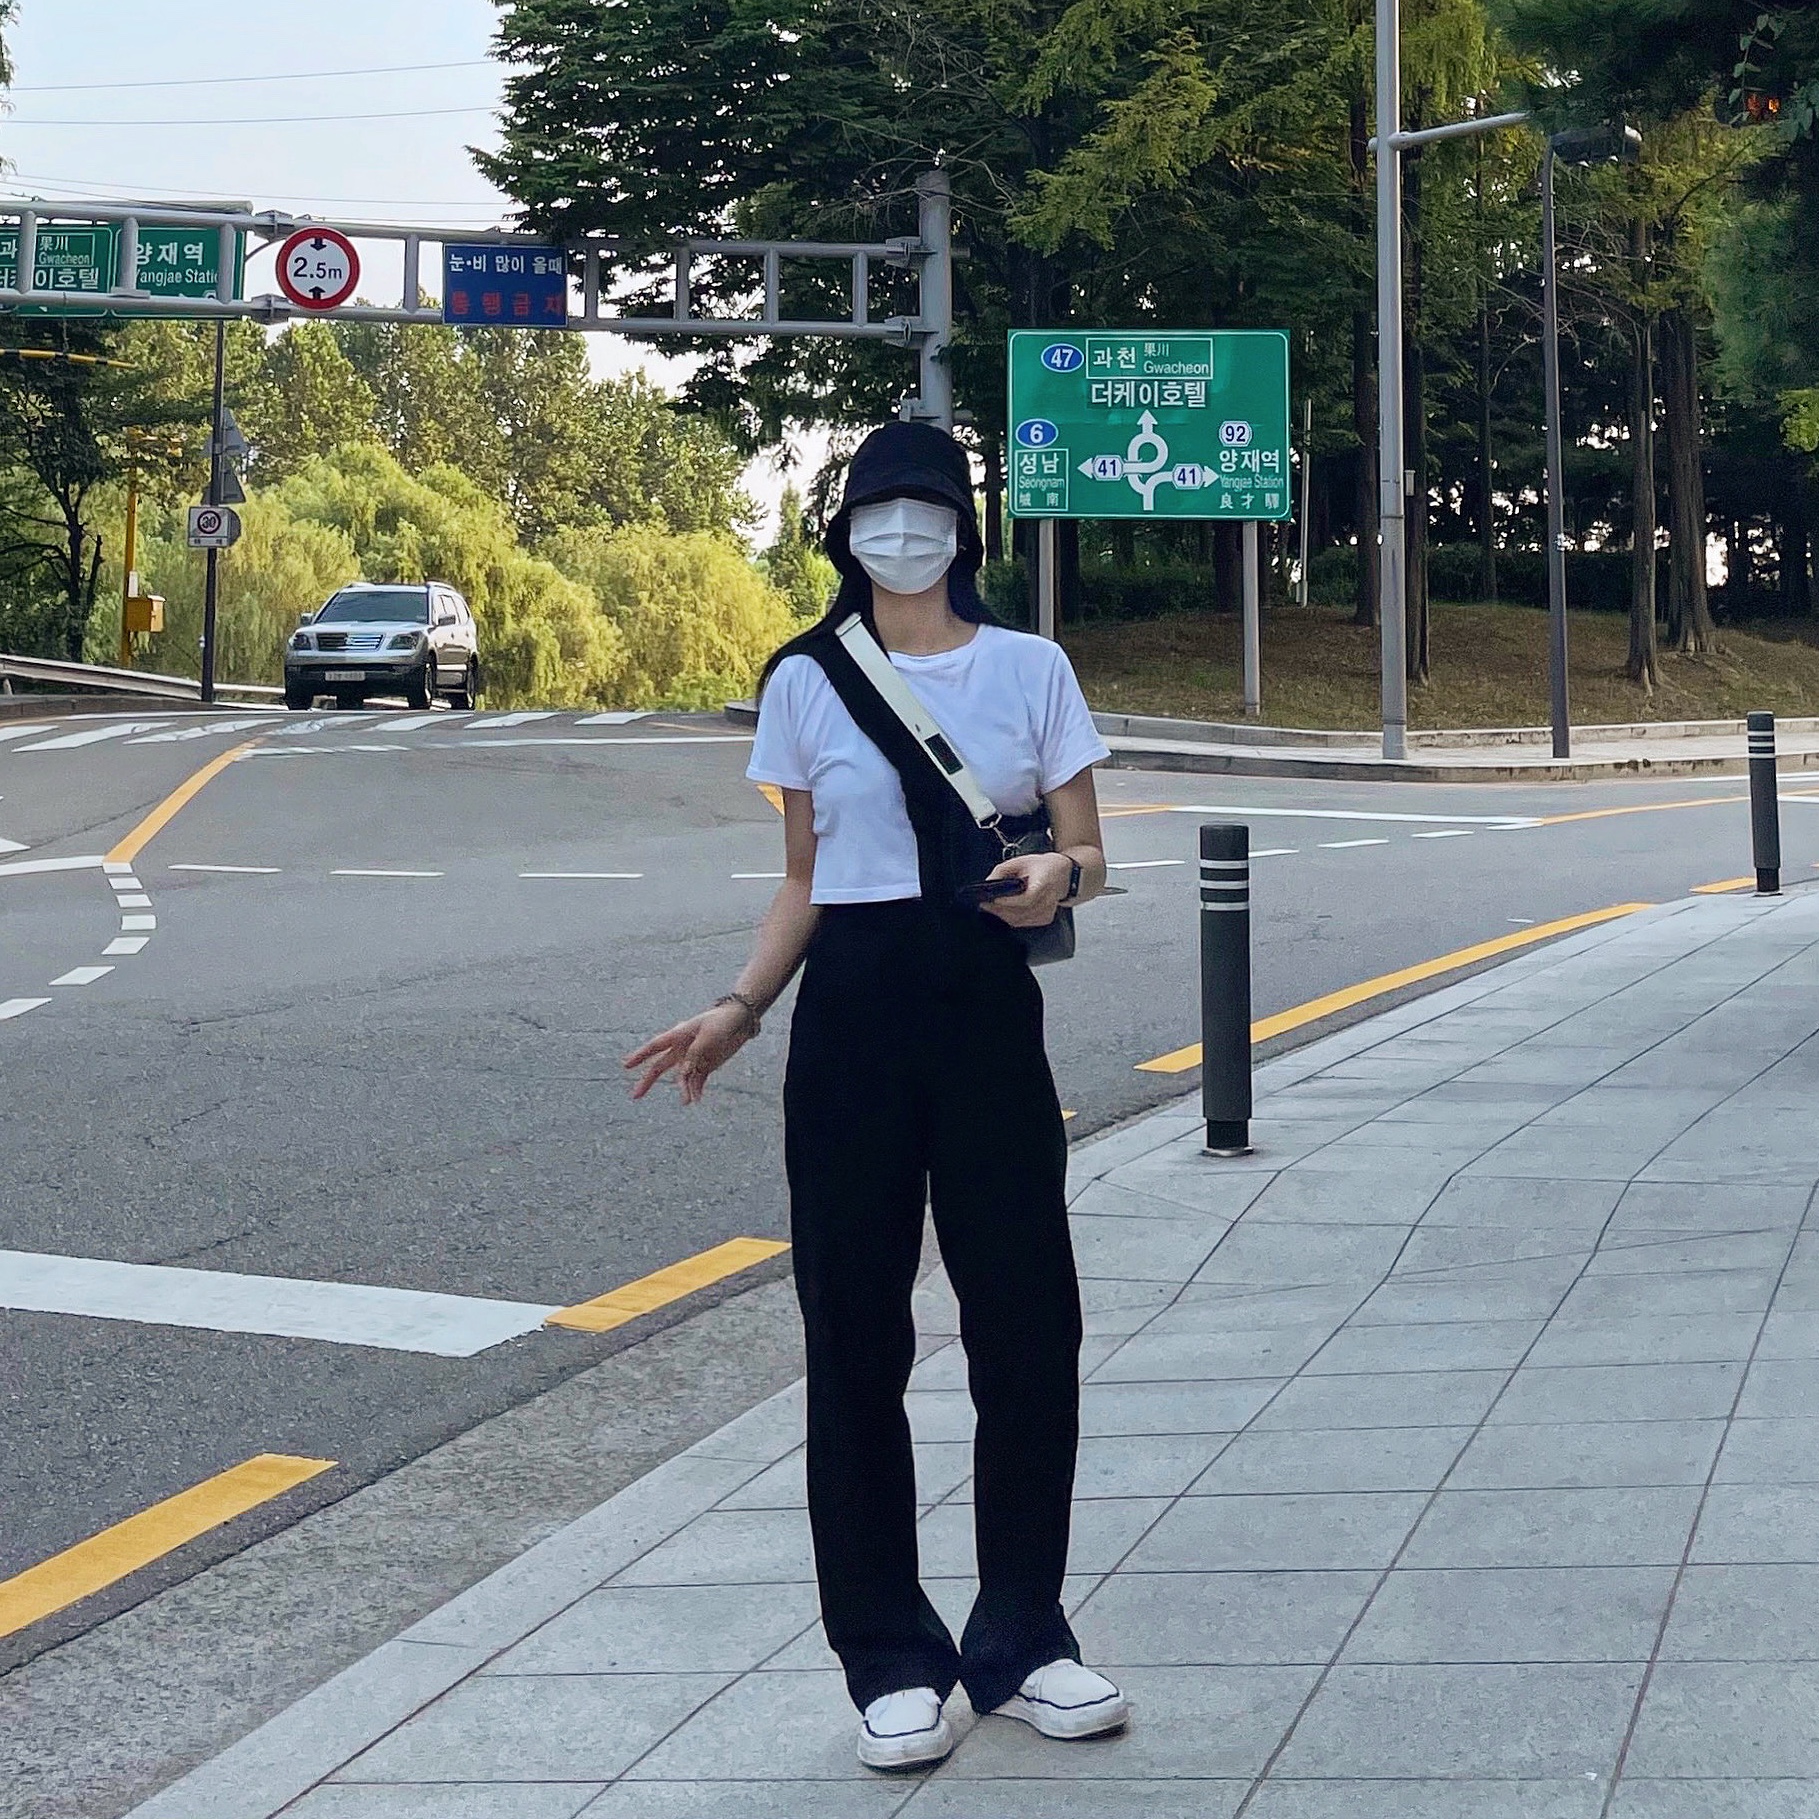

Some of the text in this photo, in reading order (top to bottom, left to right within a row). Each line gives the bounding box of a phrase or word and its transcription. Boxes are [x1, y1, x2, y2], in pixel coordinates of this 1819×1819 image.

[0, 238, 18, 259] 과
[39, 235, 69, 251] 果川
[39, 251, 91, 265] Gwacheon
[136, 241, 204, 266] 양재역
[293, 256, 342, 279] 2.5m
[495, 254, 525, 274] 많이
[532, 256, 563, 275] 올때
[185, 267, 218, 284] Stati
[1050, 348, 1074, 368] 47
[1092, 346, 1137, 369] 과천
[1143, 342, 1170, 357] 果川
[1143, 361, 1209, 375] Gwacheon
[1091, 380, 1206, 408] 더케이호텔
[1029, 423, 1044, 444] 6
[1225, 425, 1246, 443] 92
[1019, 452, 1060, 475] 성남
[1097, 459, 1117, 476] 41
[1219, 448, 1280, 474] 양재역
[1018, 475, 1065, 491] Seongnam
[1177, 468, 1196, 485] 41
[1219, 473, 1284, 492] Yangjae Station
[202, 515, 217, 529] 30
